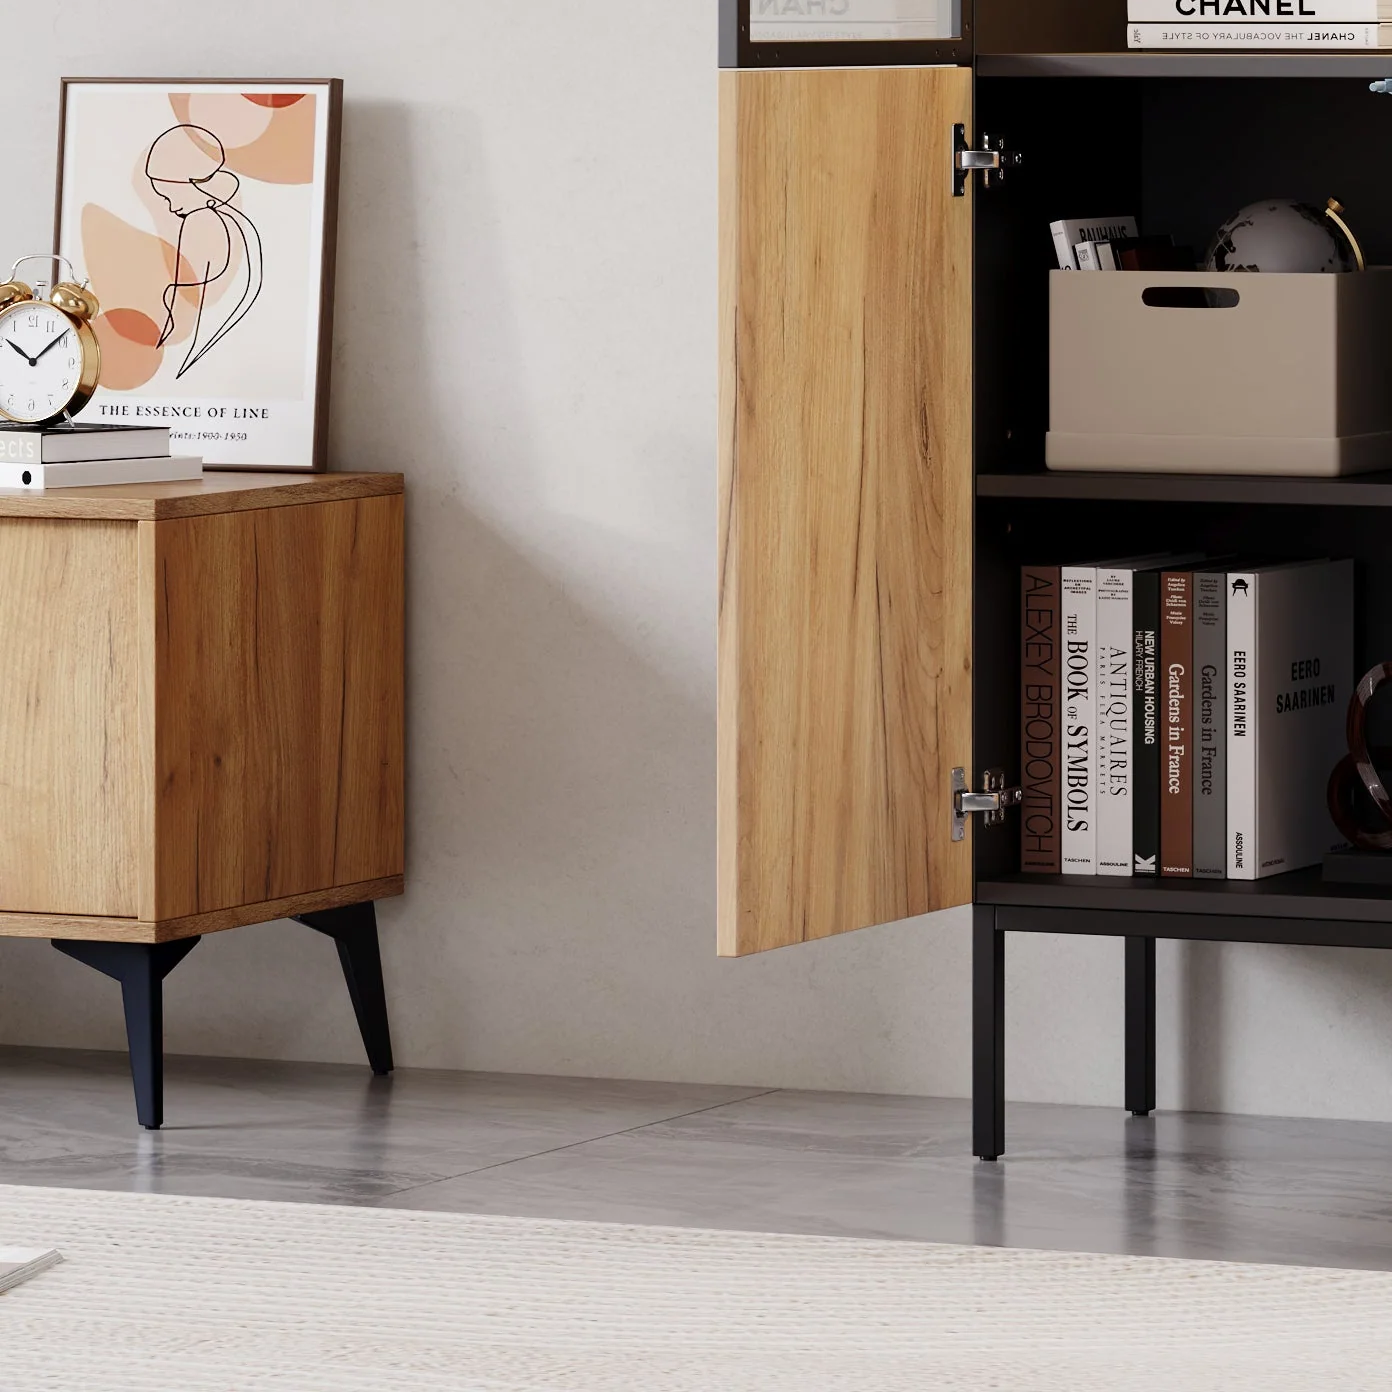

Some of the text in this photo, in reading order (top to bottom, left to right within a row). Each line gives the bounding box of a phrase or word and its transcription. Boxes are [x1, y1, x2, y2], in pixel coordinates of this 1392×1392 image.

[99, 404, 269, 419] THE ESSENCE OF LINE
[1135, 630, 1144, 691] HILARY FRENCH
[1144, 630, 1156, 746] NEW URBAN HOUSING
[1233, 650, 1247, 737] EERO SAARINEN
[1276, 685, 1335, 714] SAARINEN
[1291, 657, 1320, 682] EERO
[1023, 573, 1054, 853] ALEXEY BRODOVITCH
[1066, 613, 1089, 832] THE BOOK OF SYMBOLS
[1106, 646, 1129, 797] ANTIQUAIRES
[1168, 663, 1186, 795] Gardens in France
[1200, 664, 1218, 796] Gardens in France
[1235, 831, 1244, 869] ASSOULINE
